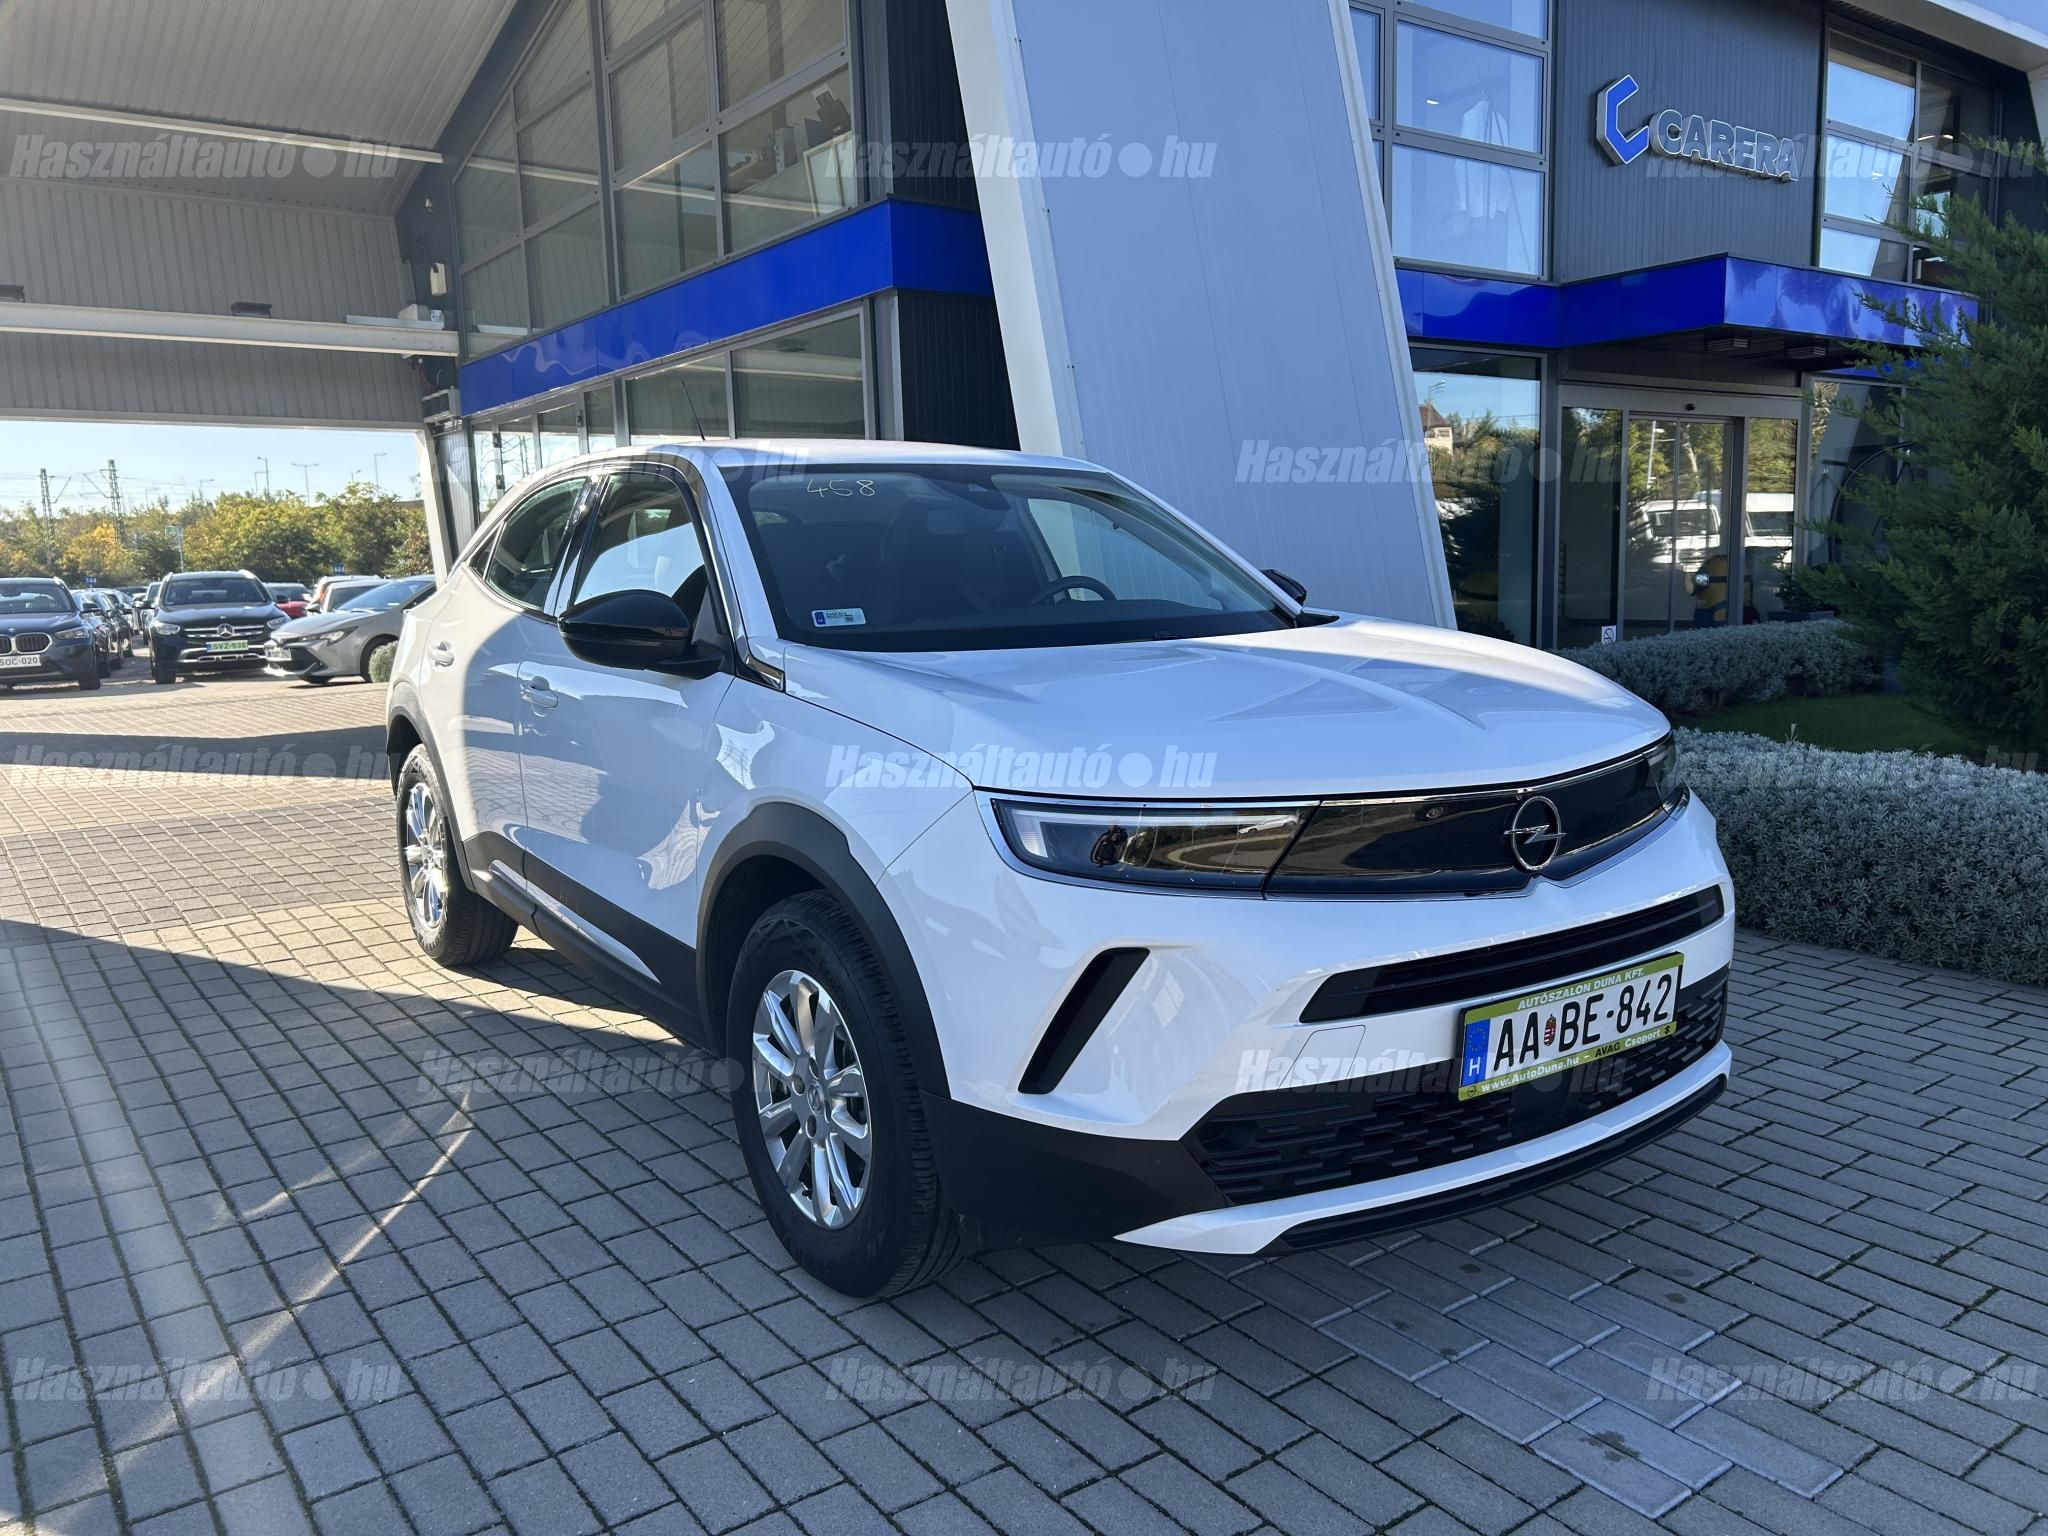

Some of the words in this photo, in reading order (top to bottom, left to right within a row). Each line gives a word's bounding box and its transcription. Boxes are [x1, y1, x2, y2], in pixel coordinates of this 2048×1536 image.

[1650, 109, 1798, 181] CARERA
[806, 479, 876, 498] 458
[1517, 984, 1592, 1010] AUTÓSZALON
[1593, 976, 1622, 990] DUNA
[1624, 967, 1645, 981] KFT.
[1594, 1041, 1621, 1058] AVAG
[1624, 1028, 1661, 1049] Csoport
[1468, 1056, 1481, 1077] H
